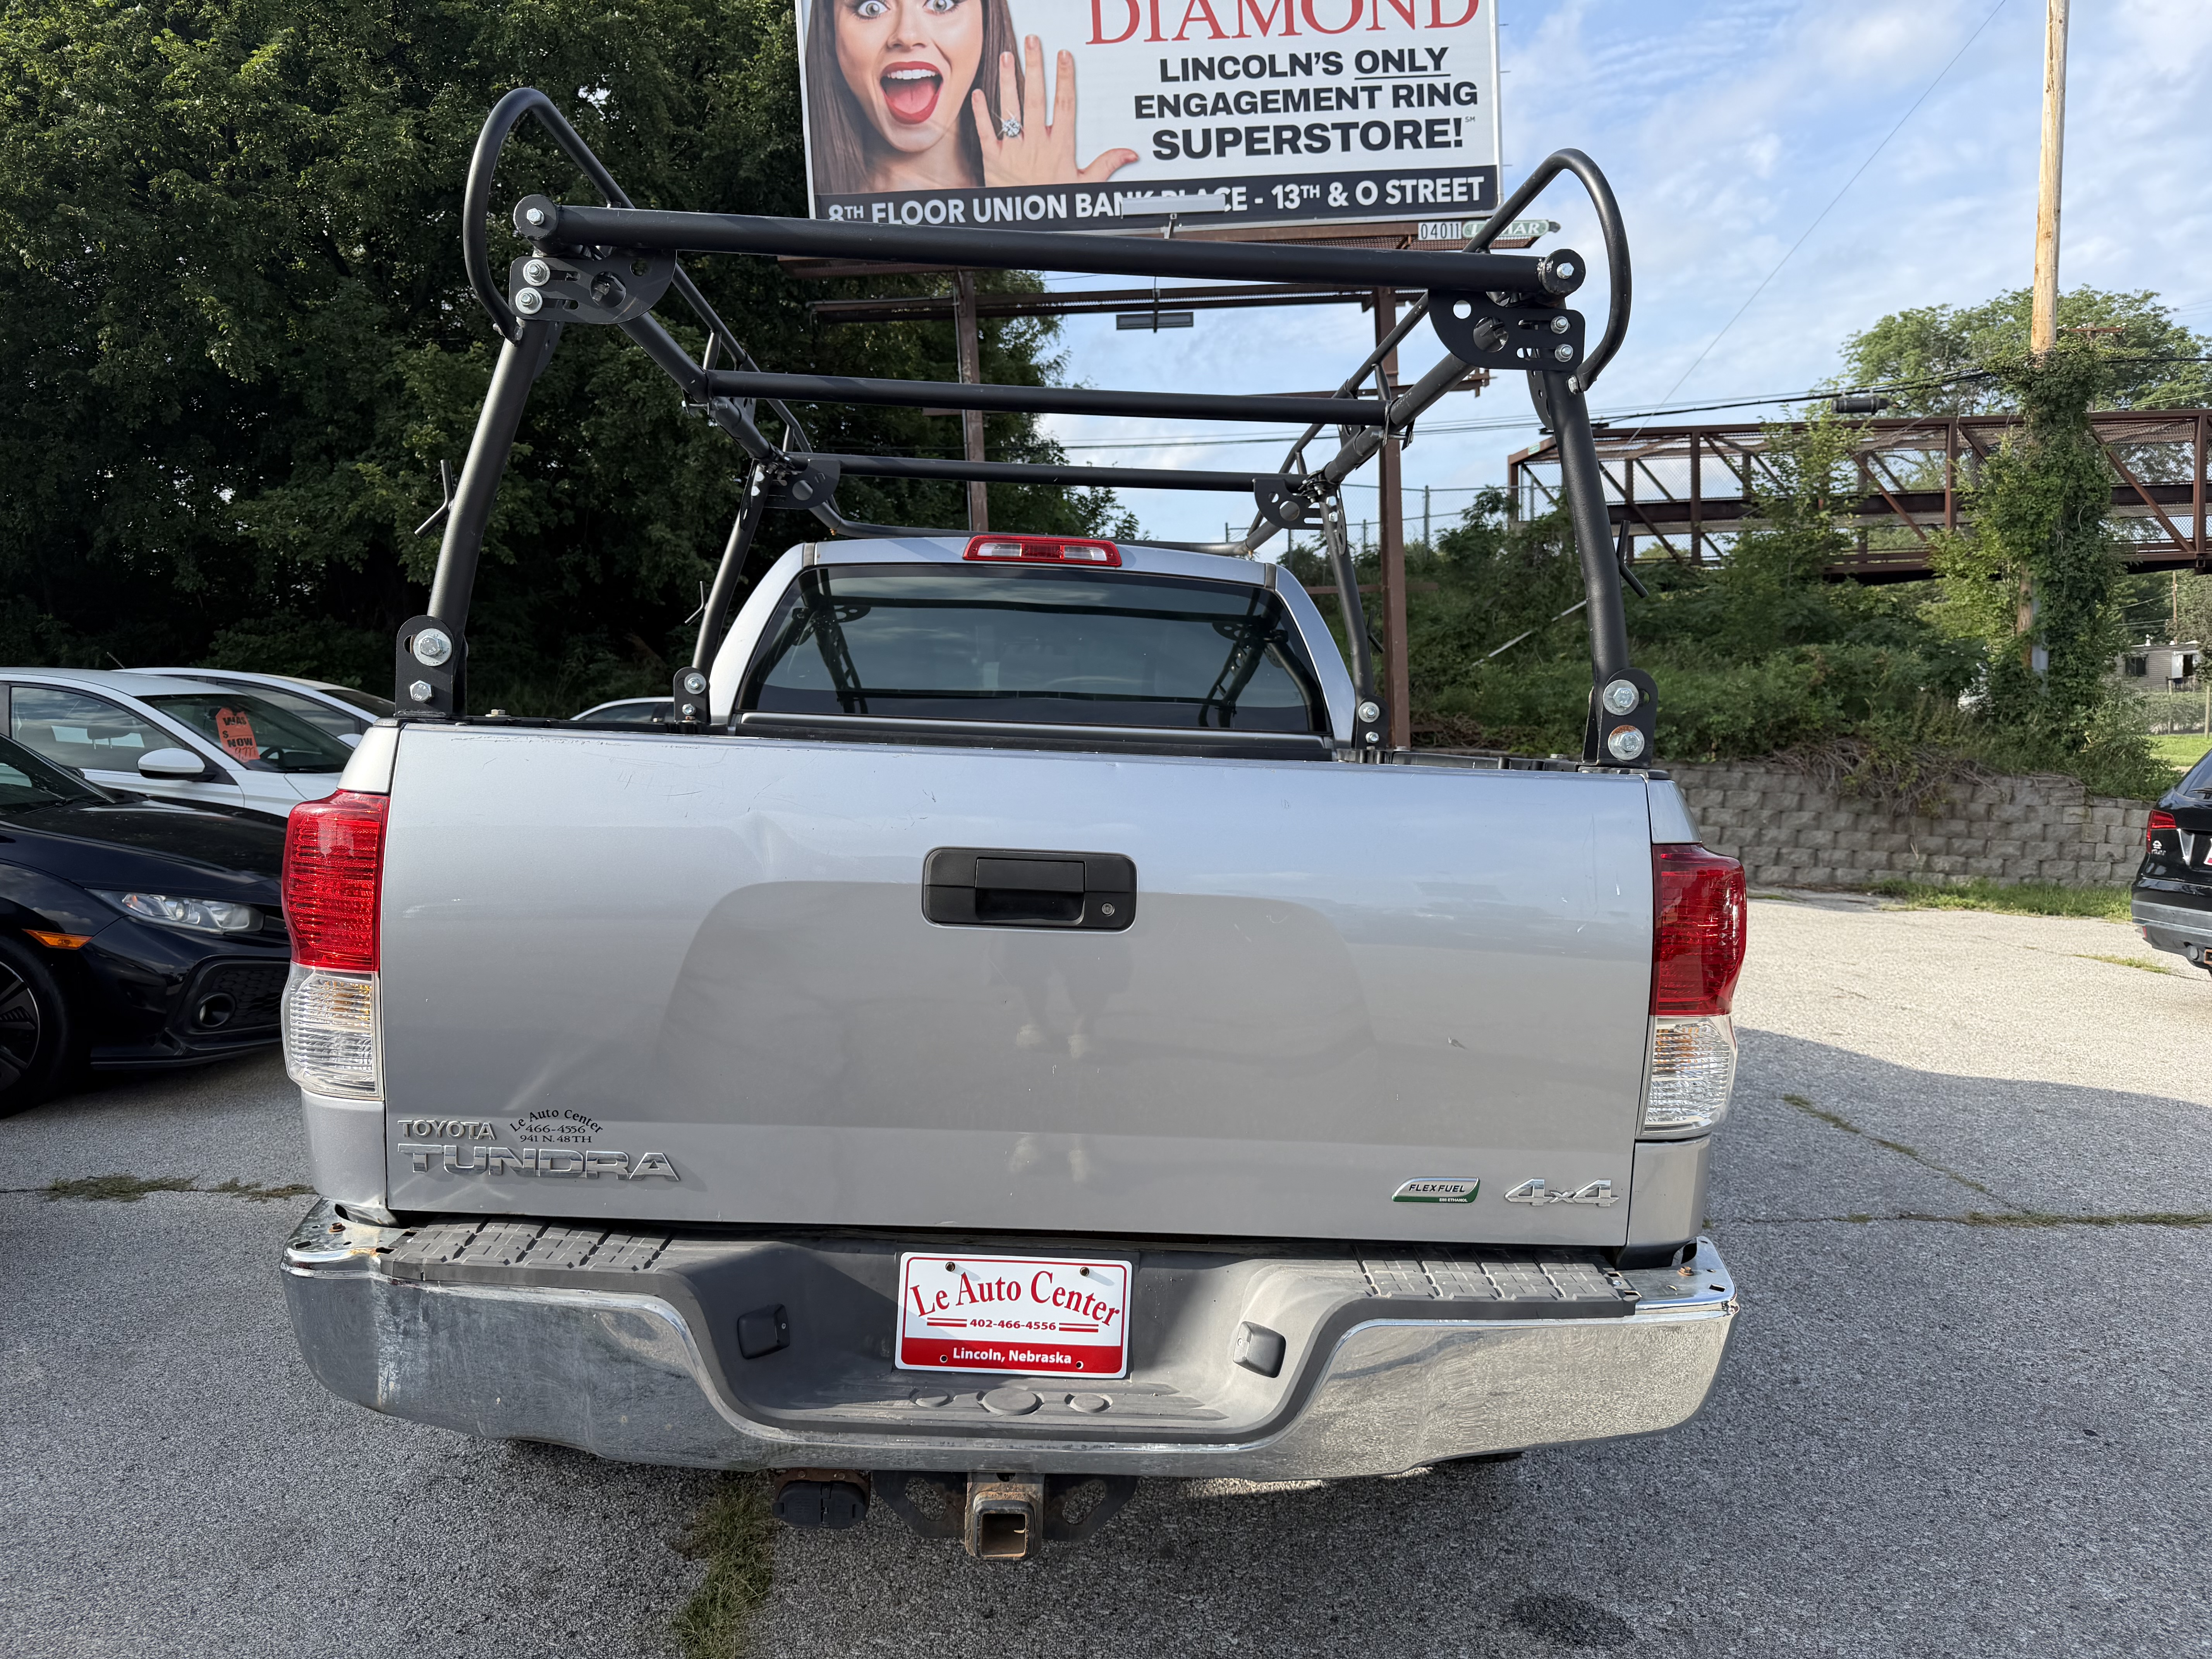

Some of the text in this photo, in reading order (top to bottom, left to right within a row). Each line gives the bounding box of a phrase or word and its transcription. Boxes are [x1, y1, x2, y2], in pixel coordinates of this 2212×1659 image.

[1160, 47, 1449, 82] LINCOLN'S ONLY
[1135, 82, 1478, 119] ENGAGEMENT RING
[1152, 118, 1463, 160] SUPERSTORE!
[828, 204, 864, 221] 8TH
[871, 199, 966, 225] FLOOR
[973, 194, 1067, 223] UNION
[1271, 184, 1320, 209] 13TH
[1327, 181, 1349, 207] &
[1355, 180, 1378, 205] O
[1385, 177, 1484, 204] STREET
[1421, 223, 1459, 239] 04011
[223, 716, 246, 725] WAS
[227, 738, 253, 747] NOW
[397, 1120, 497, 1140] TOYOTA
[510, 1109, 603, 1133] Le Auto Center
[525, 1124, 586, 1133] 466-4556
[520, 1134, 538, 1142] 941
[398, 1143, 681, 1181] TUNDRA
[1505, 1178, 1620, 1207] 4x4
[910, 1270, 1120, 1326] Le Auto Center
[969, 1319, 1056, 1331] 402-466-4556
[953, 1347, 1072, 1364] Lincoln, Nebraska
